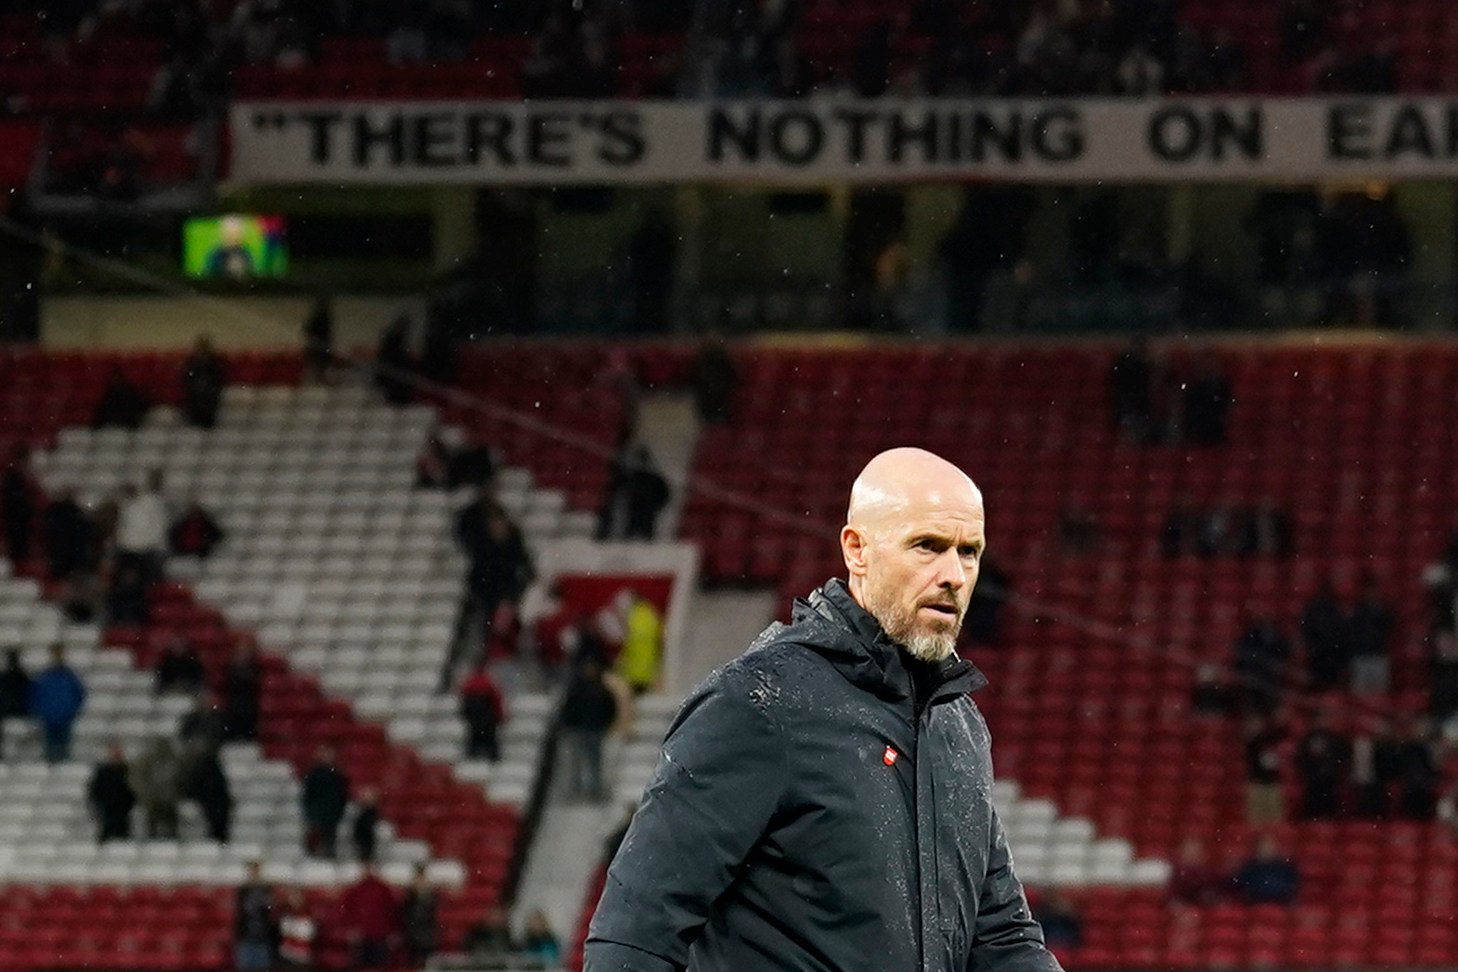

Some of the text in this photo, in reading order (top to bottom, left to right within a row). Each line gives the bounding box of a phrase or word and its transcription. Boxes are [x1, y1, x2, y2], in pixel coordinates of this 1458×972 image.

[252, 109, 646, 167] "THERE'S
[705, 105, 1086, 165] NOTHING
[1144, 103, 1265, 163] ON
